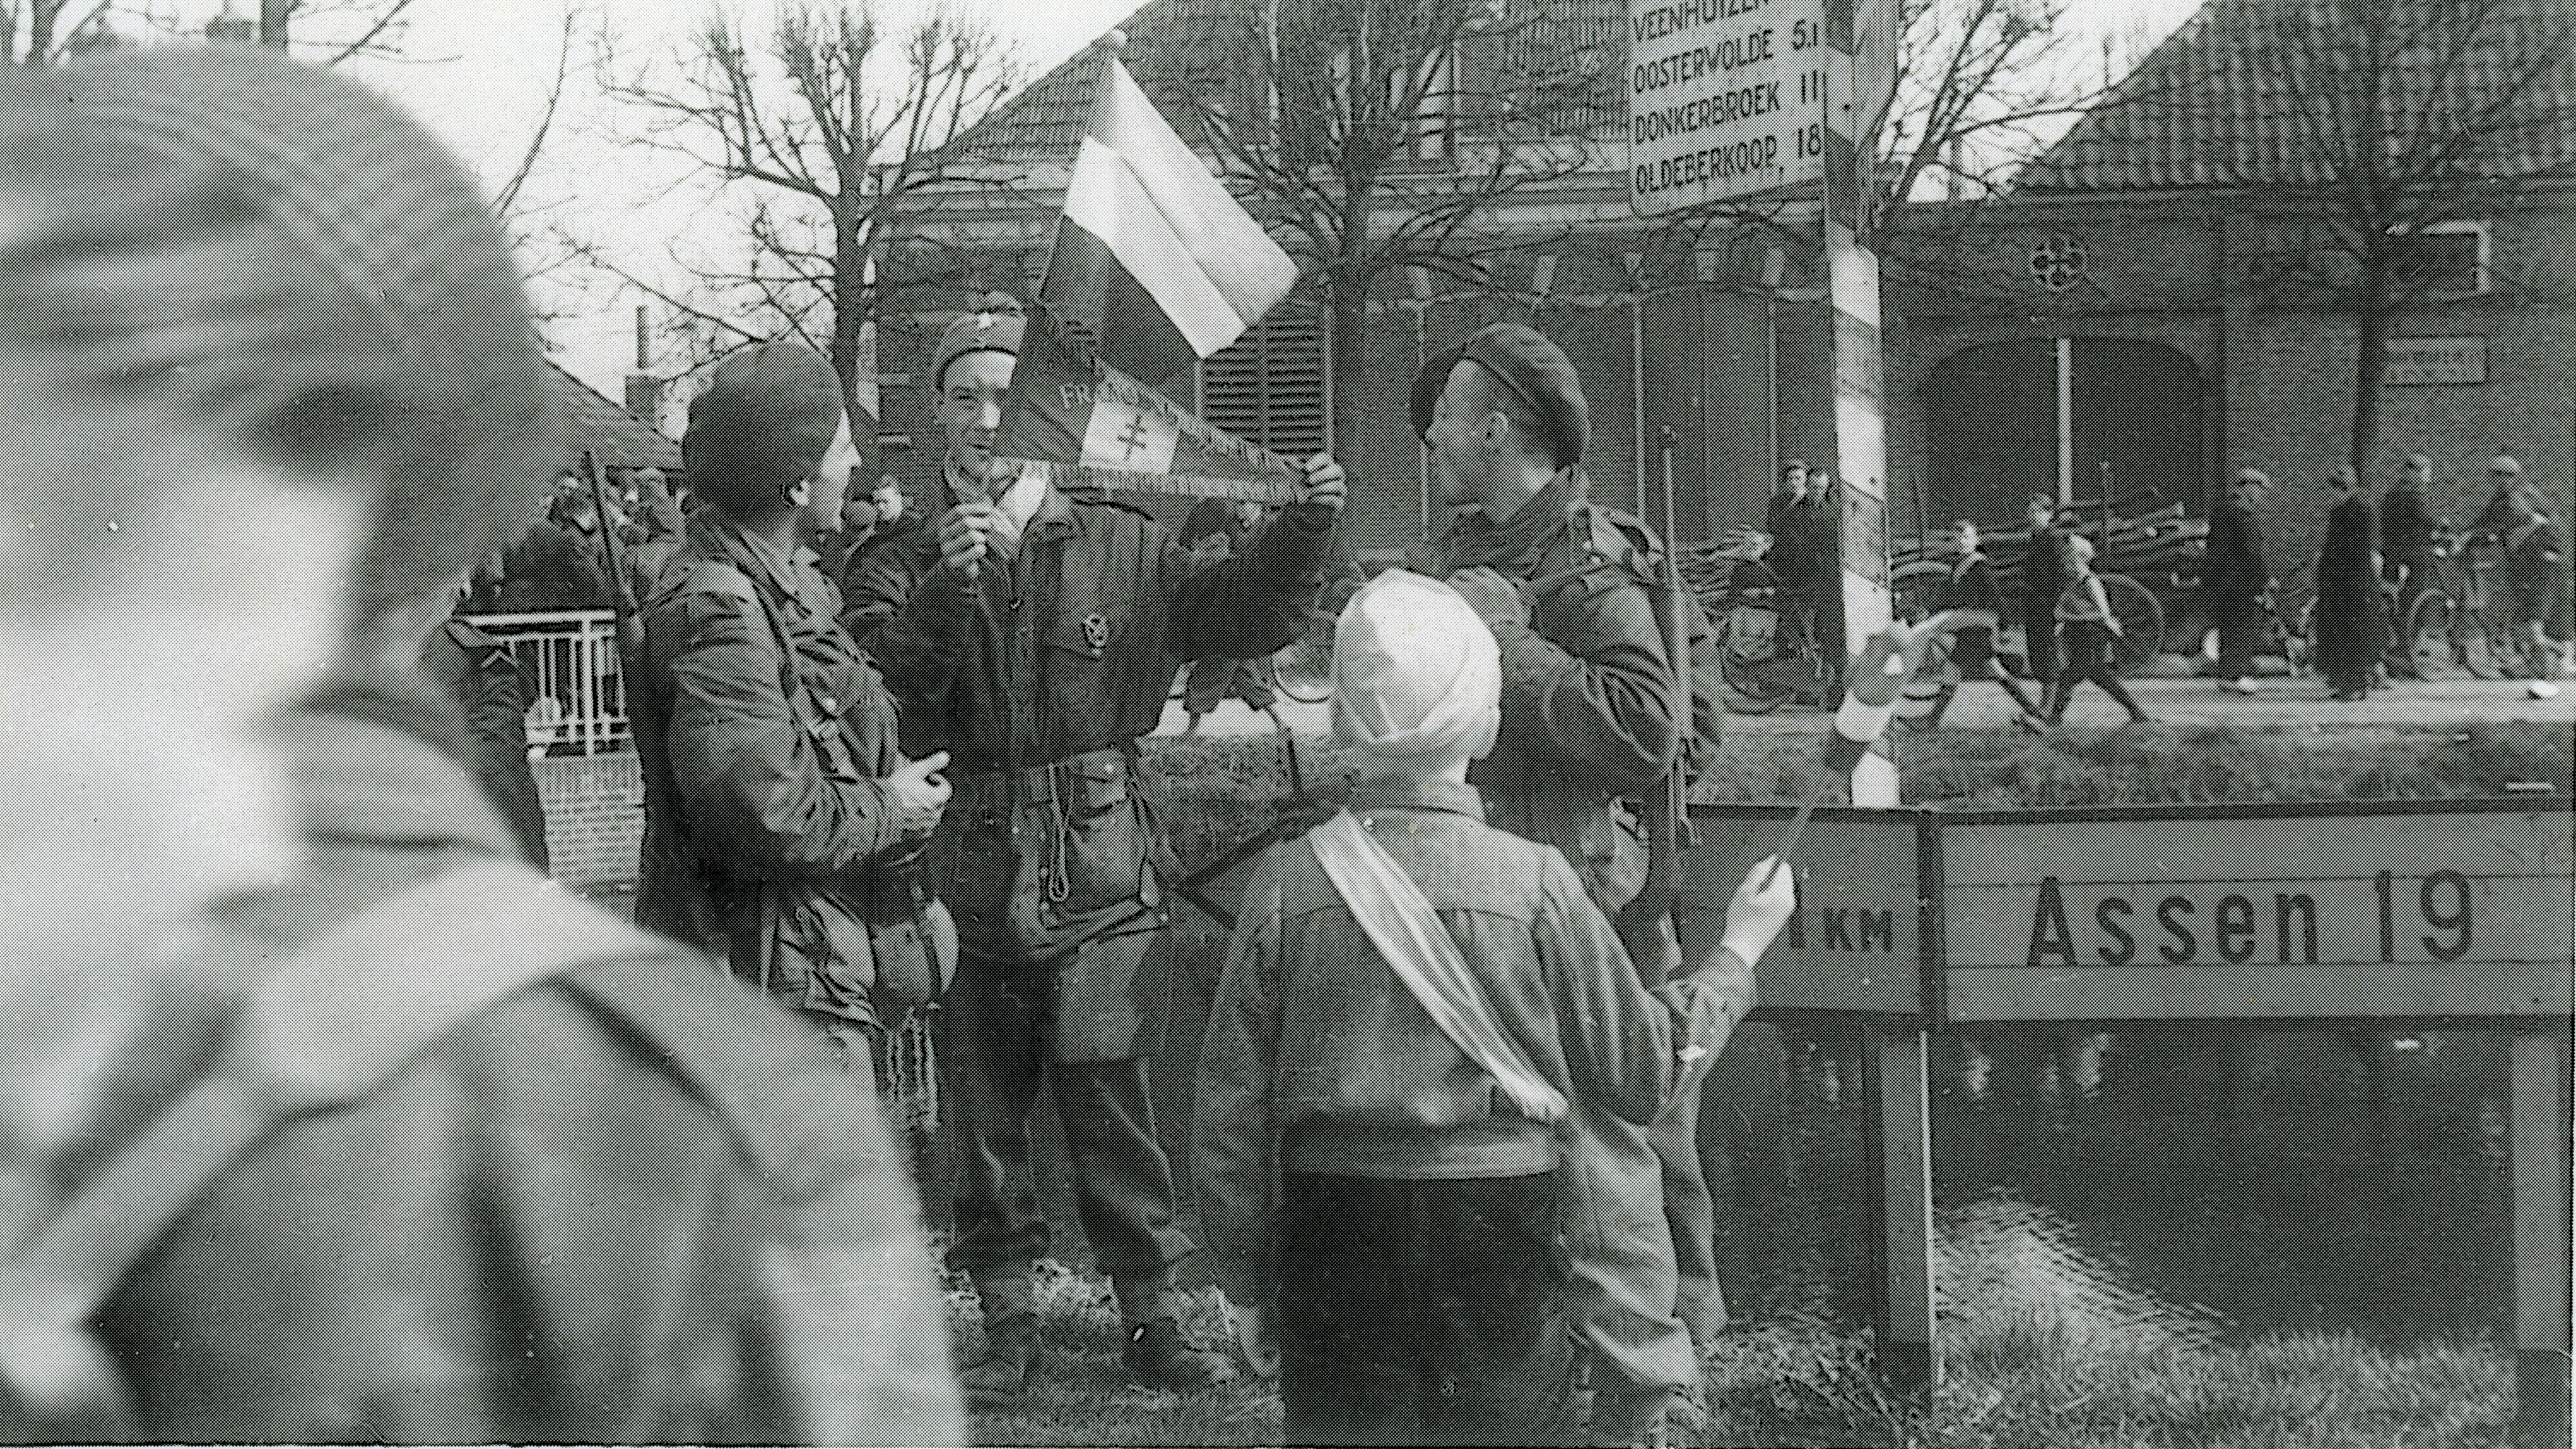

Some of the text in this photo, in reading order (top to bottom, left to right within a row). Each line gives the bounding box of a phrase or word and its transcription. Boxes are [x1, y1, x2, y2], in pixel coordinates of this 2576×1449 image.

[1633, 19, 1818, 94] OOSTERWOLDE 5.1
[1635, 70, 1818, 144] DONKERBROEK 11
[1796, 123, 1822, 159] 18
[1822, 905, 1893, 952] KM
[2026, 869, 2473, 967] Assen 19
